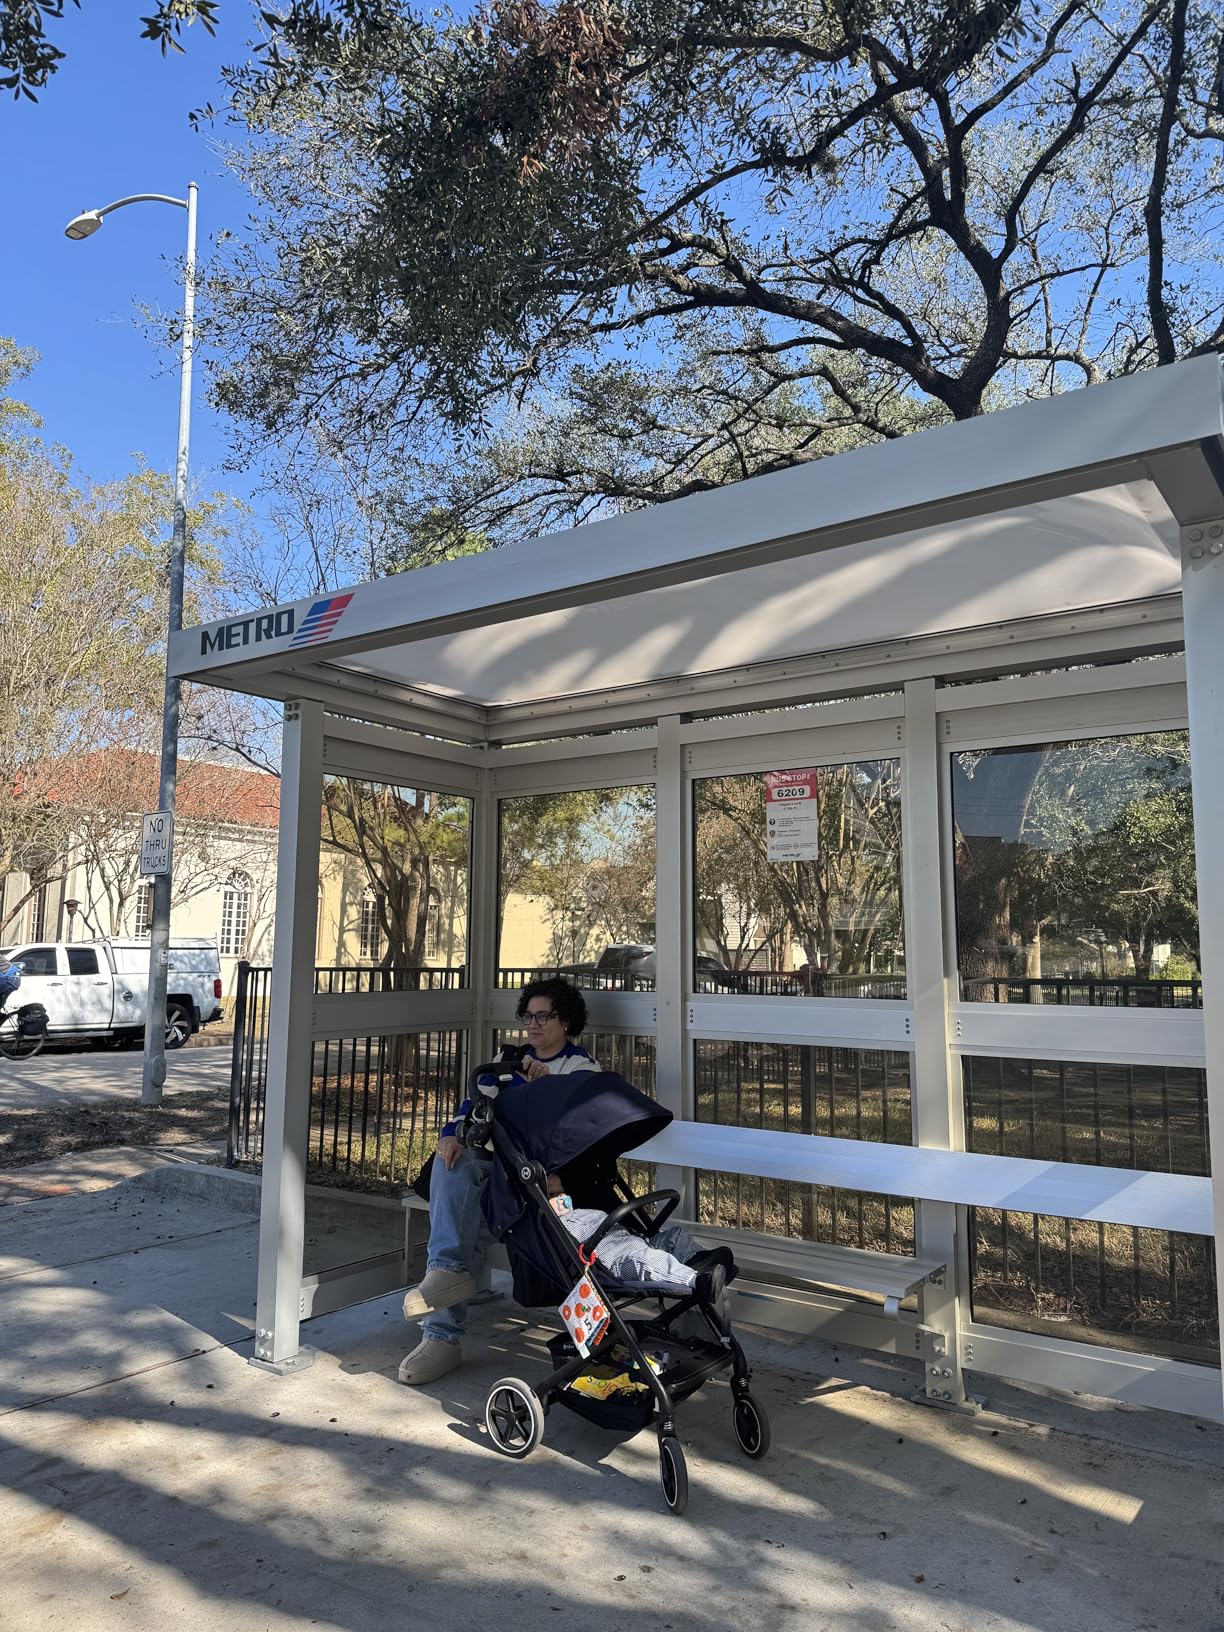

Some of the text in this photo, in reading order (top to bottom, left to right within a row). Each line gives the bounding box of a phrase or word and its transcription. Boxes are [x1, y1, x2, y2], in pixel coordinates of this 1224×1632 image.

[200, 608, 295, 656] METRO
[777, 787, 805, 798] 6209
[150, 818, 164, 833] NO
[145, 838, 166, 851] THRU
[143, 855, 166, 868] TRUCKS
[584, 1318, 593, 1331] 5
